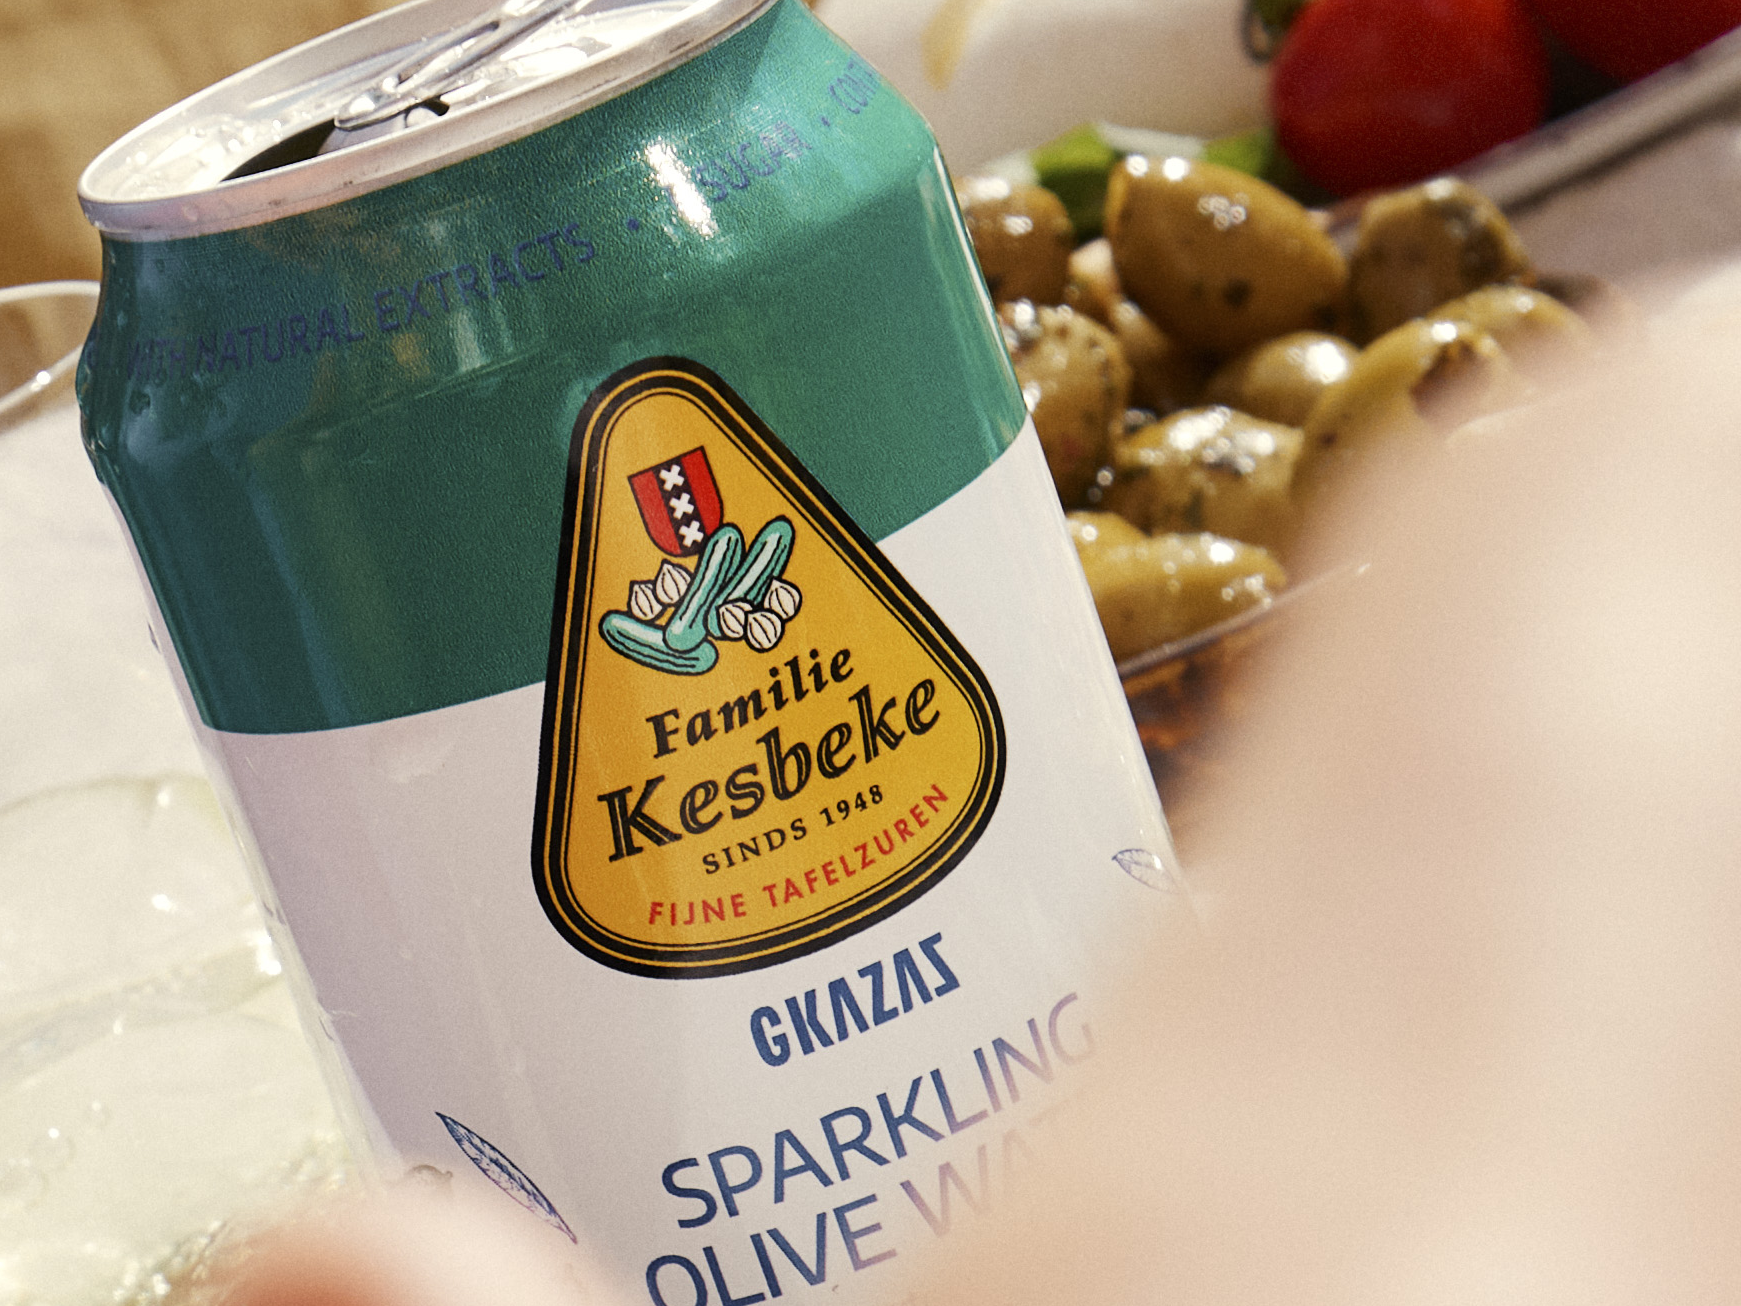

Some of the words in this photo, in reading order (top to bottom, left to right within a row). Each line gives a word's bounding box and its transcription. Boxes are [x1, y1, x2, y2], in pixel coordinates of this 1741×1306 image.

[194, 302, 365, 373] NATURAL
[374, 221, 596, 332] EXTRACTS
[597, 677, 941, 863] Kesbeke
[645, 647, 855, 759] Familie
[648, 892, 748, 927] FIJNE
[762, 782, 950, 908] TAFELZUREN
[701, 818, 808, 875] SINDS
[819, 784, 884, 826] 1948
[660, 991, 1099, 1230] SPARKLING
